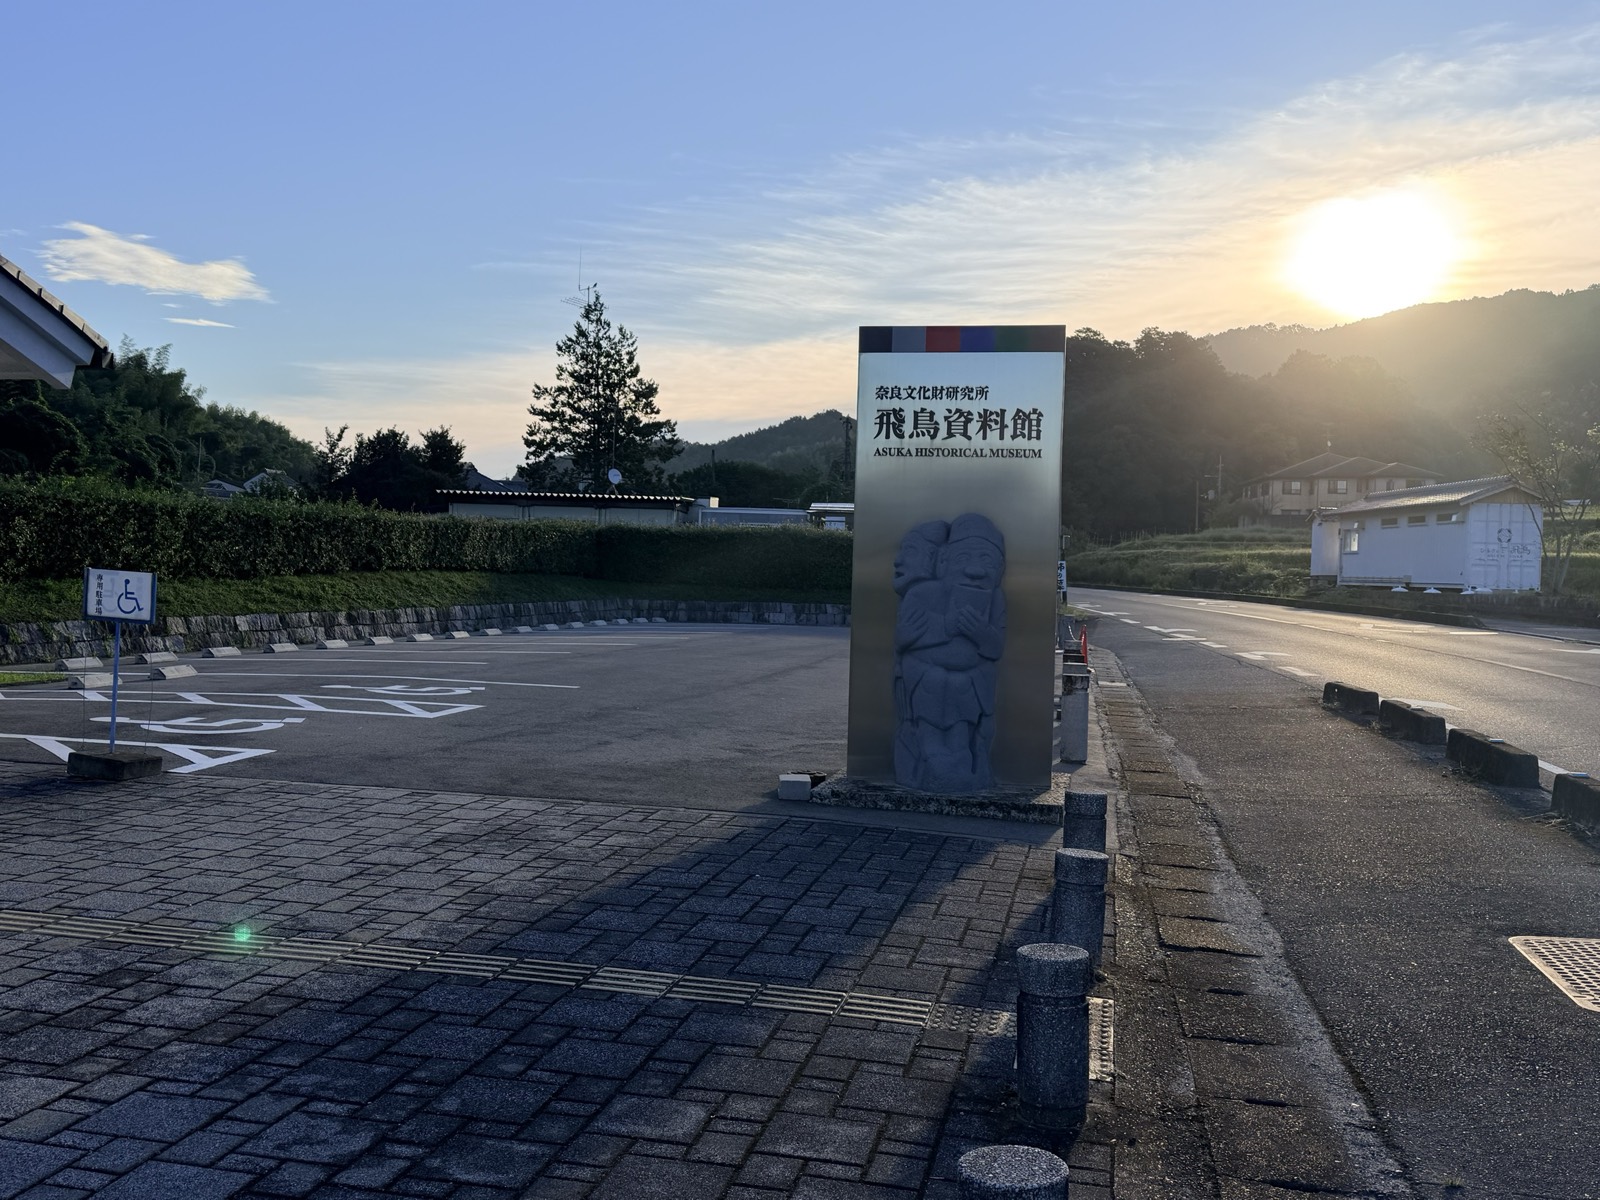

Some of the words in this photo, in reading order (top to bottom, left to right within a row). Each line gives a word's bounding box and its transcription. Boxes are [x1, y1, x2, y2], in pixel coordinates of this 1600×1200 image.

[875, 385, 989, 401] 奈良文化財研究所
[873, 407, 1044, 441] 飛鳥資料館
[873, 447, 913, 457] ASUKA
[915, 447, 987, 458] HISTORICAL
[989, 448, 1042, 459] MUSEUM
